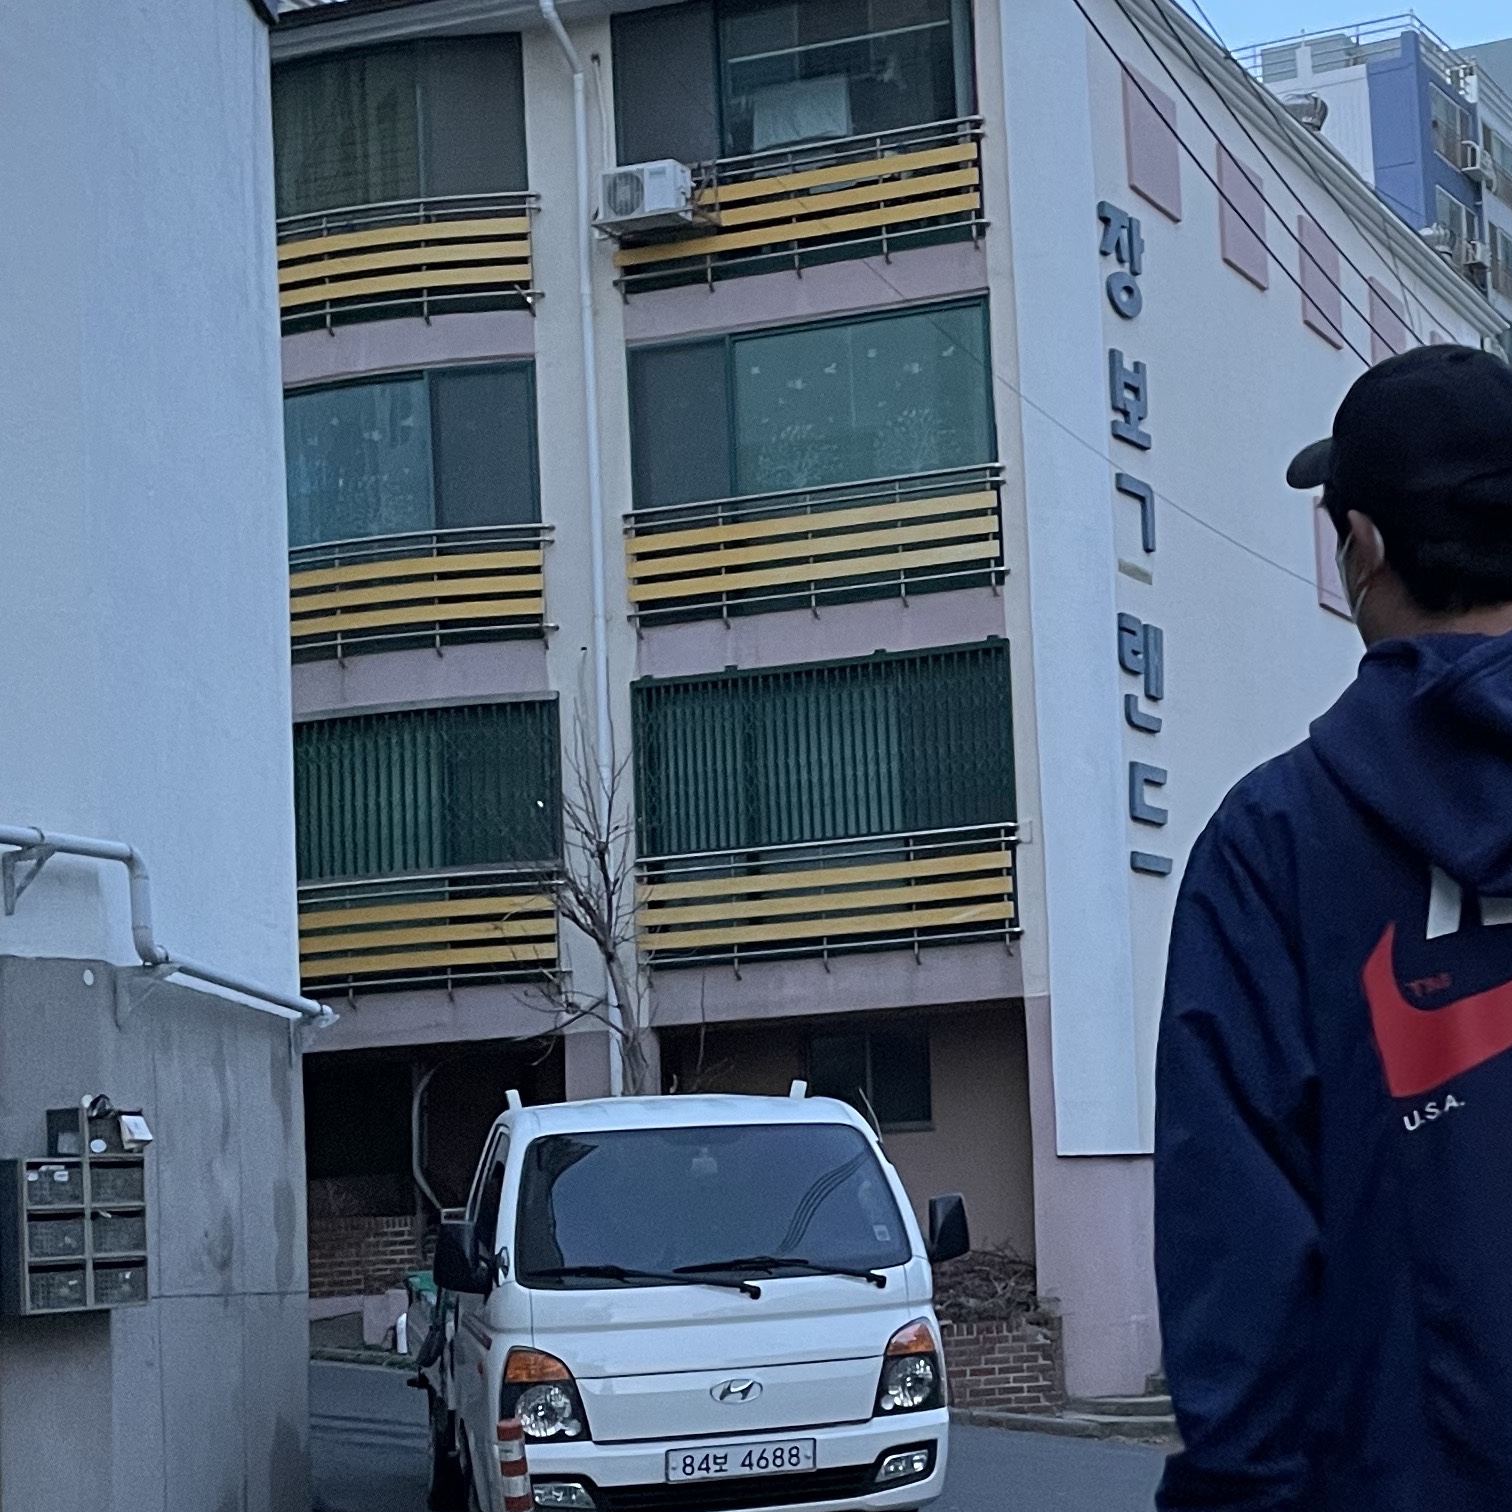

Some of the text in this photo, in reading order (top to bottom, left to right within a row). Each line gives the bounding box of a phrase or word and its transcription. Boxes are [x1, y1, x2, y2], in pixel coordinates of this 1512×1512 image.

[1403, 1095, 1465, 1131] U.S.A.
[682, 1445, 801, 1476] 84보 4688
